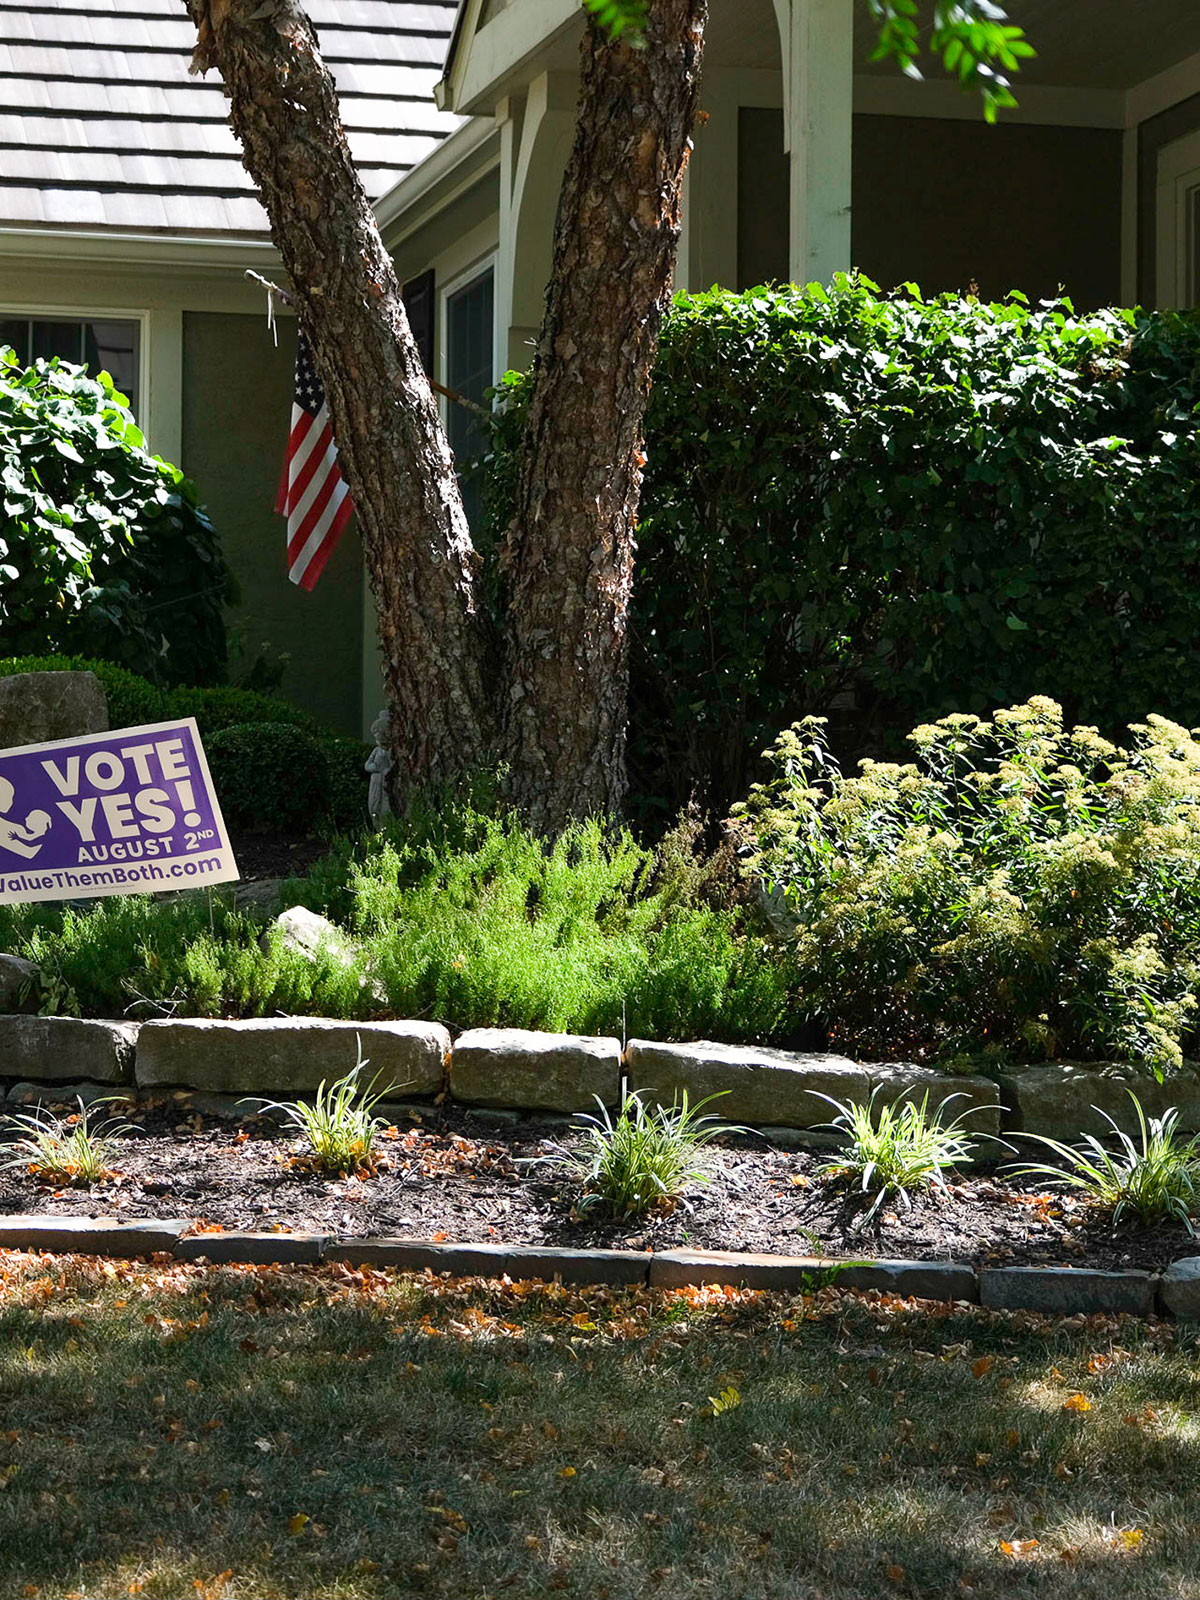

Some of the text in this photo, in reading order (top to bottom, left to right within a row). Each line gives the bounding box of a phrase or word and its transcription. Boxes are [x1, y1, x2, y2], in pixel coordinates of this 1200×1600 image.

[41, 738, 191, 797] VOTE
[56, 780, 202, 842] YES!
[78, 829, 215, 863] AUGUST 2ND
